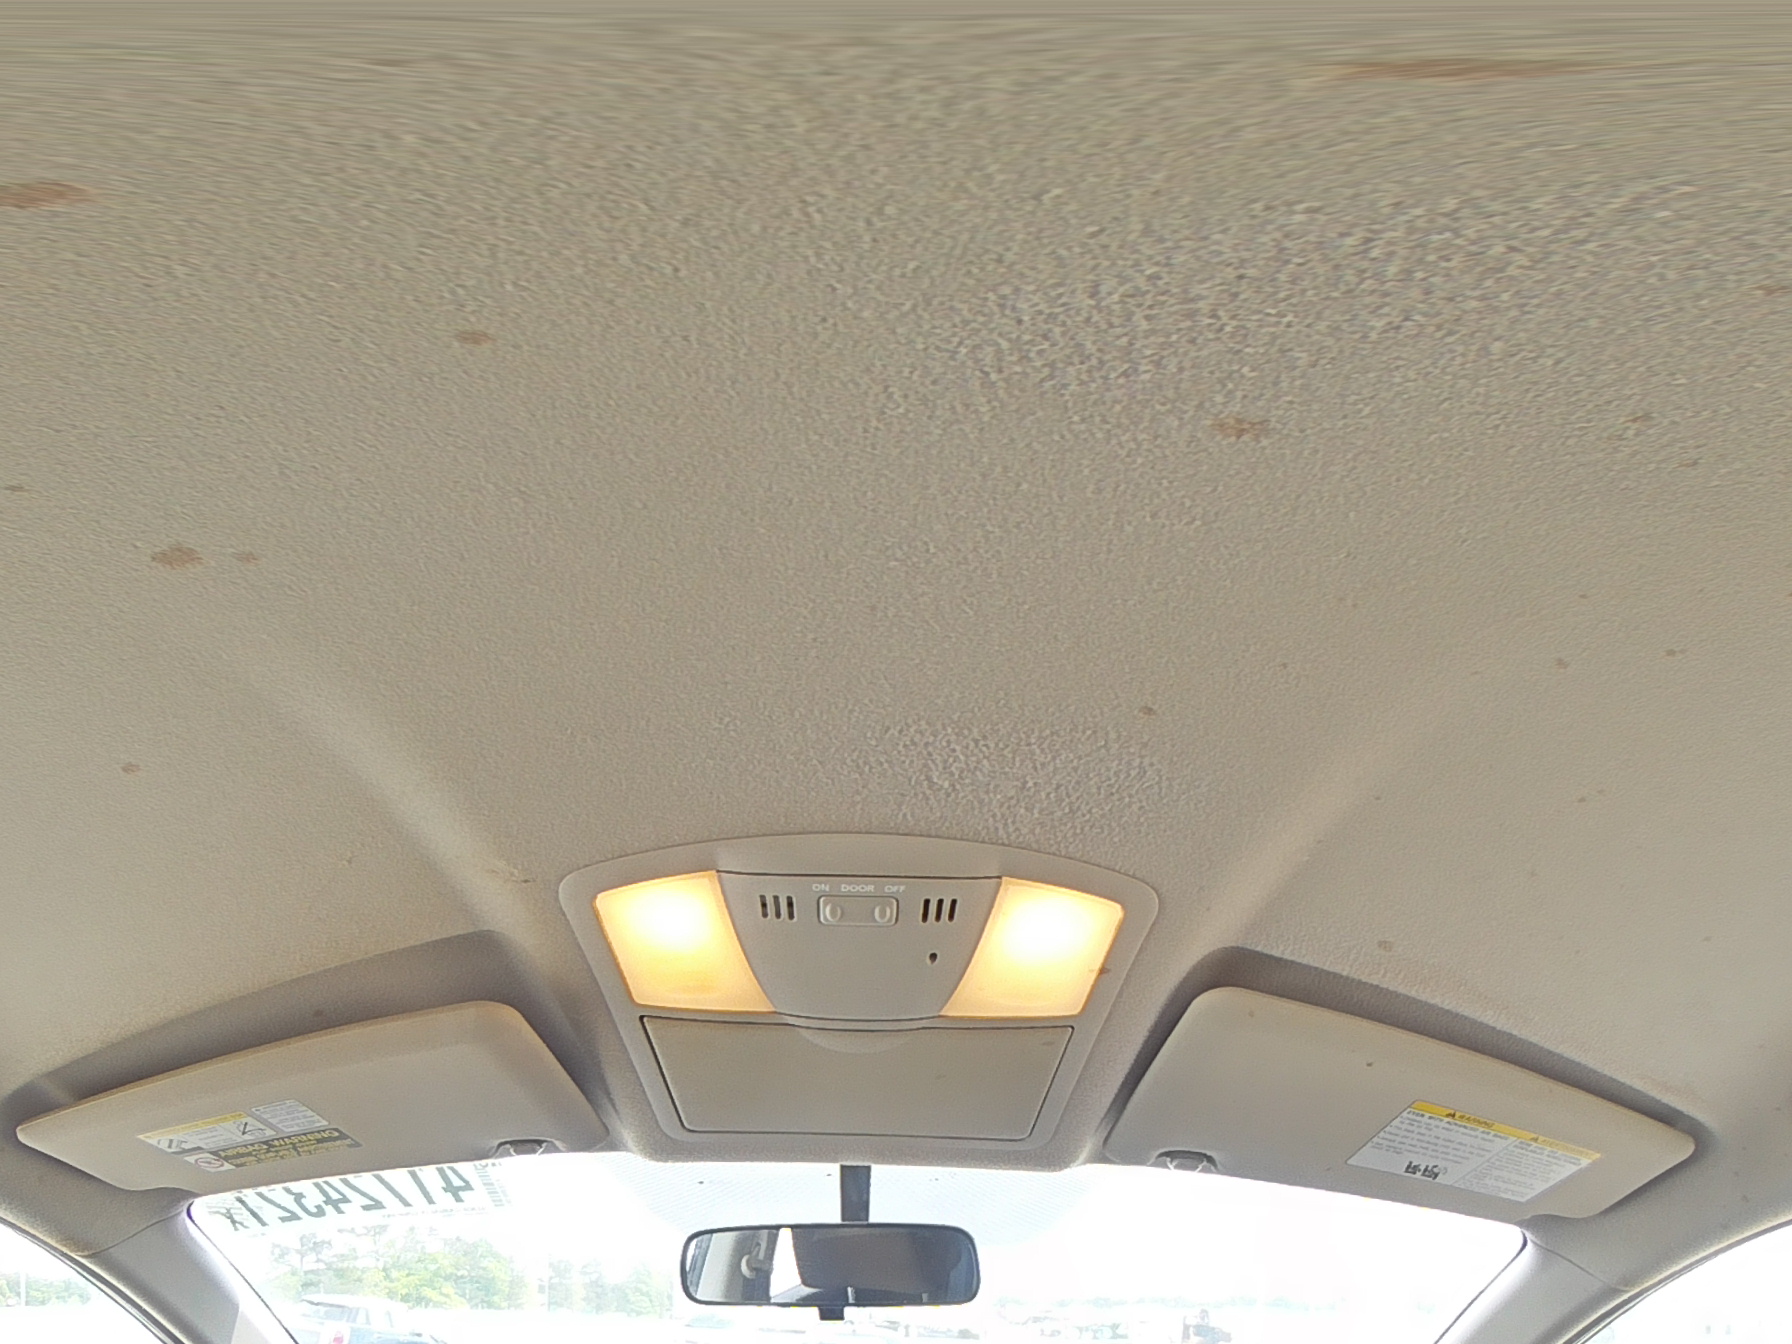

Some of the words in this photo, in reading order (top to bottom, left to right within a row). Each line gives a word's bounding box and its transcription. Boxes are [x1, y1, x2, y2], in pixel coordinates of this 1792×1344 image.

[811, 883, 830, 892] ON
[840, 884, 876, 893] DOOR
[883, 884, 906, 893] OFF
